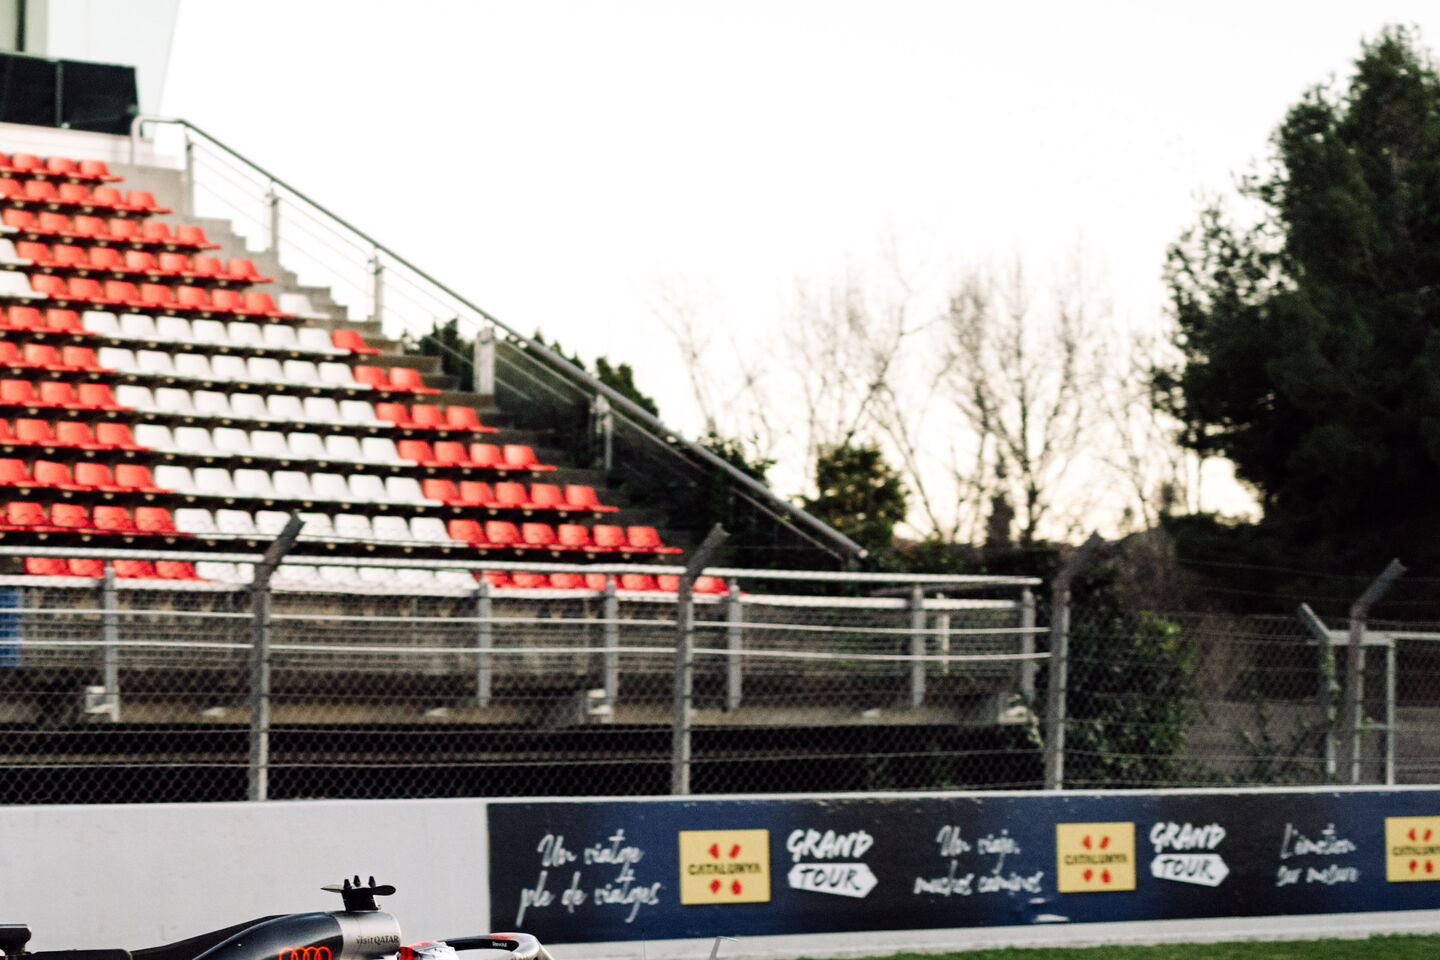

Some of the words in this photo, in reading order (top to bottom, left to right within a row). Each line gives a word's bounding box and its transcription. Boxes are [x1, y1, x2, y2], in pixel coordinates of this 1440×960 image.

[537, 833, 577, 867] Un
[786, 828, 874, 862] GRAND
[1149, 822, 1226, 854] GRAND
[688, 863, 762, 876] CATALUNYA
[800, 868, 861, 892] TOUR
[1161, 858, 1215, 880] TOUR
